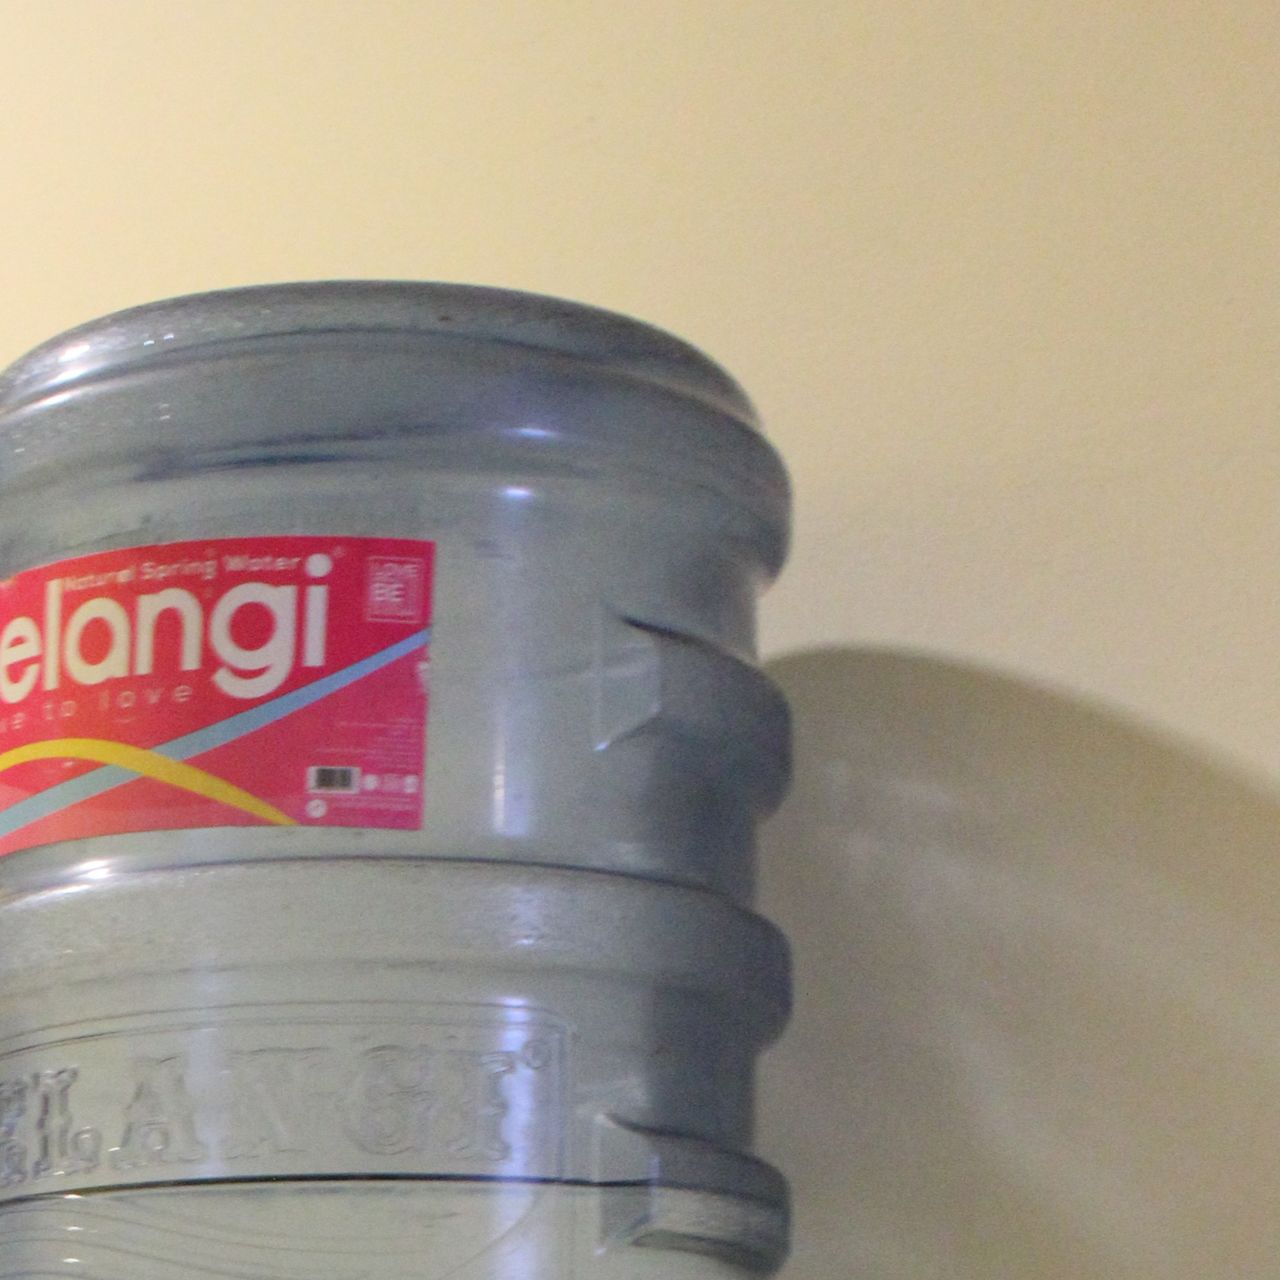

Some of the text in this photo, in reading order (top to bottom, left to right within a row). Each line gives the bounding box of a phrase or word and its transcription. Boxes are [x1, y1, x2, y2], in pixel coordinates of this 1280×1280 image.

[140, 560, 218, 582] Spring
[224, 555, 301, 573] Water
[369, 583, 405, 602] BE
[43, 699, 78, 721] to
[98, 684, 194, 712] love
